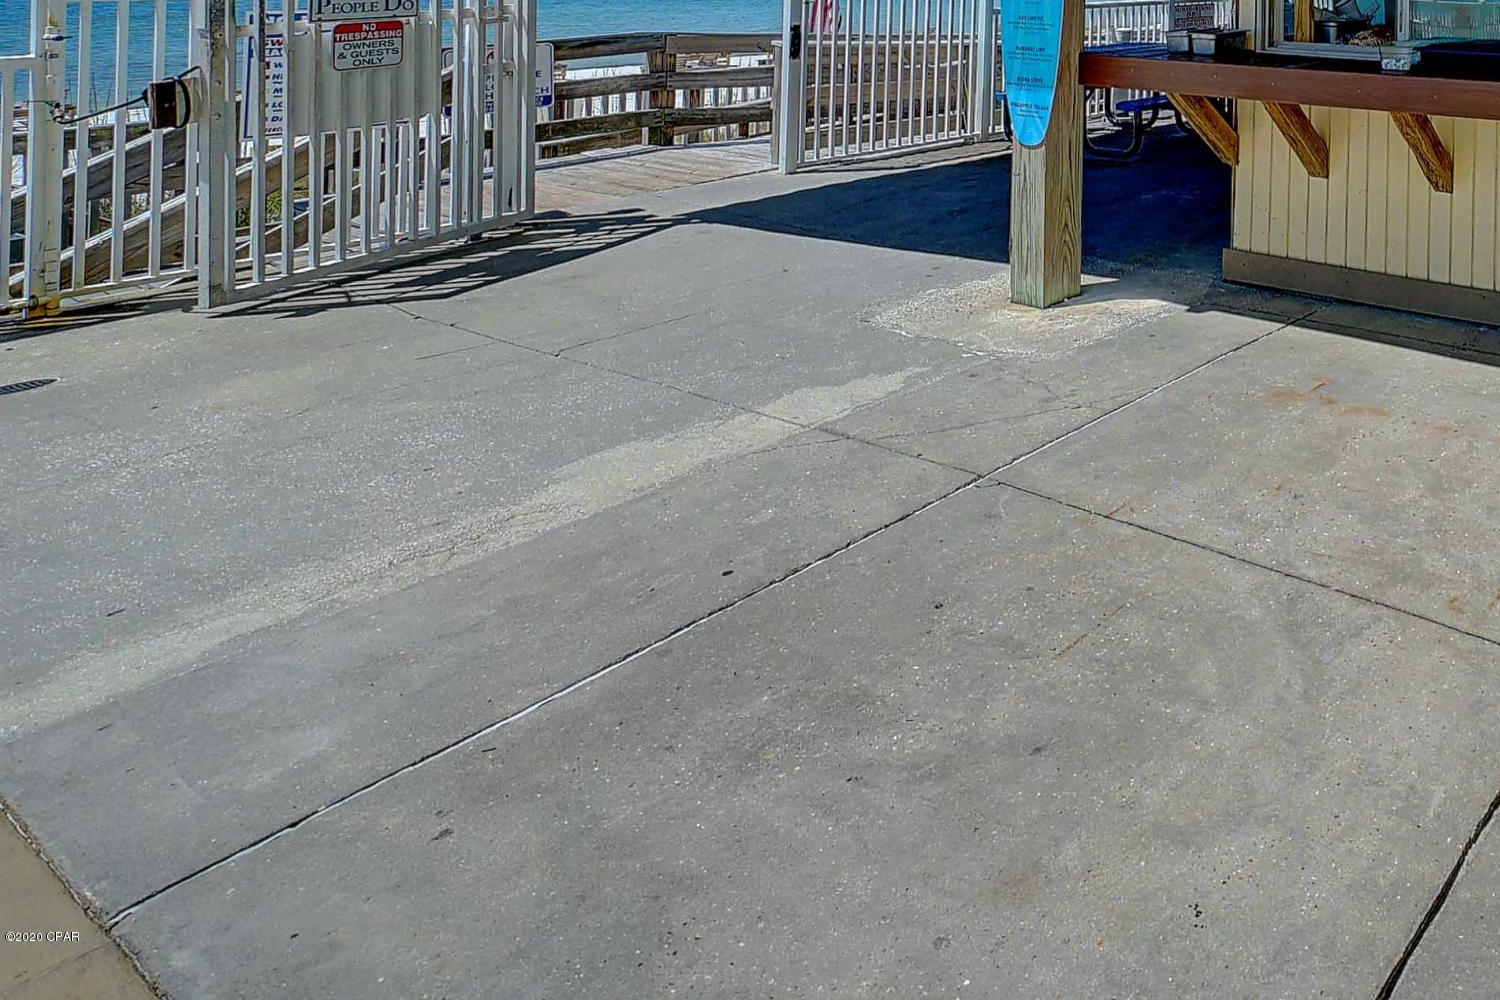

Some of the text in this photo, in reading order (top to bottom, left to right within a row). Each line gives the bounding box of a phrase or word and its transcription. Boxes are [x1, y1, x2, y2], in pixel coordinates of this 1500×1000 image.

[362, 23, 377, 31] NO
[335, 30, 402, 41] TRESPASSING
[342, 40, 395, 51] OWNERS
[337, 47, 400, 60] & GUESTS
[352, 57, 385, 66] ONLY
